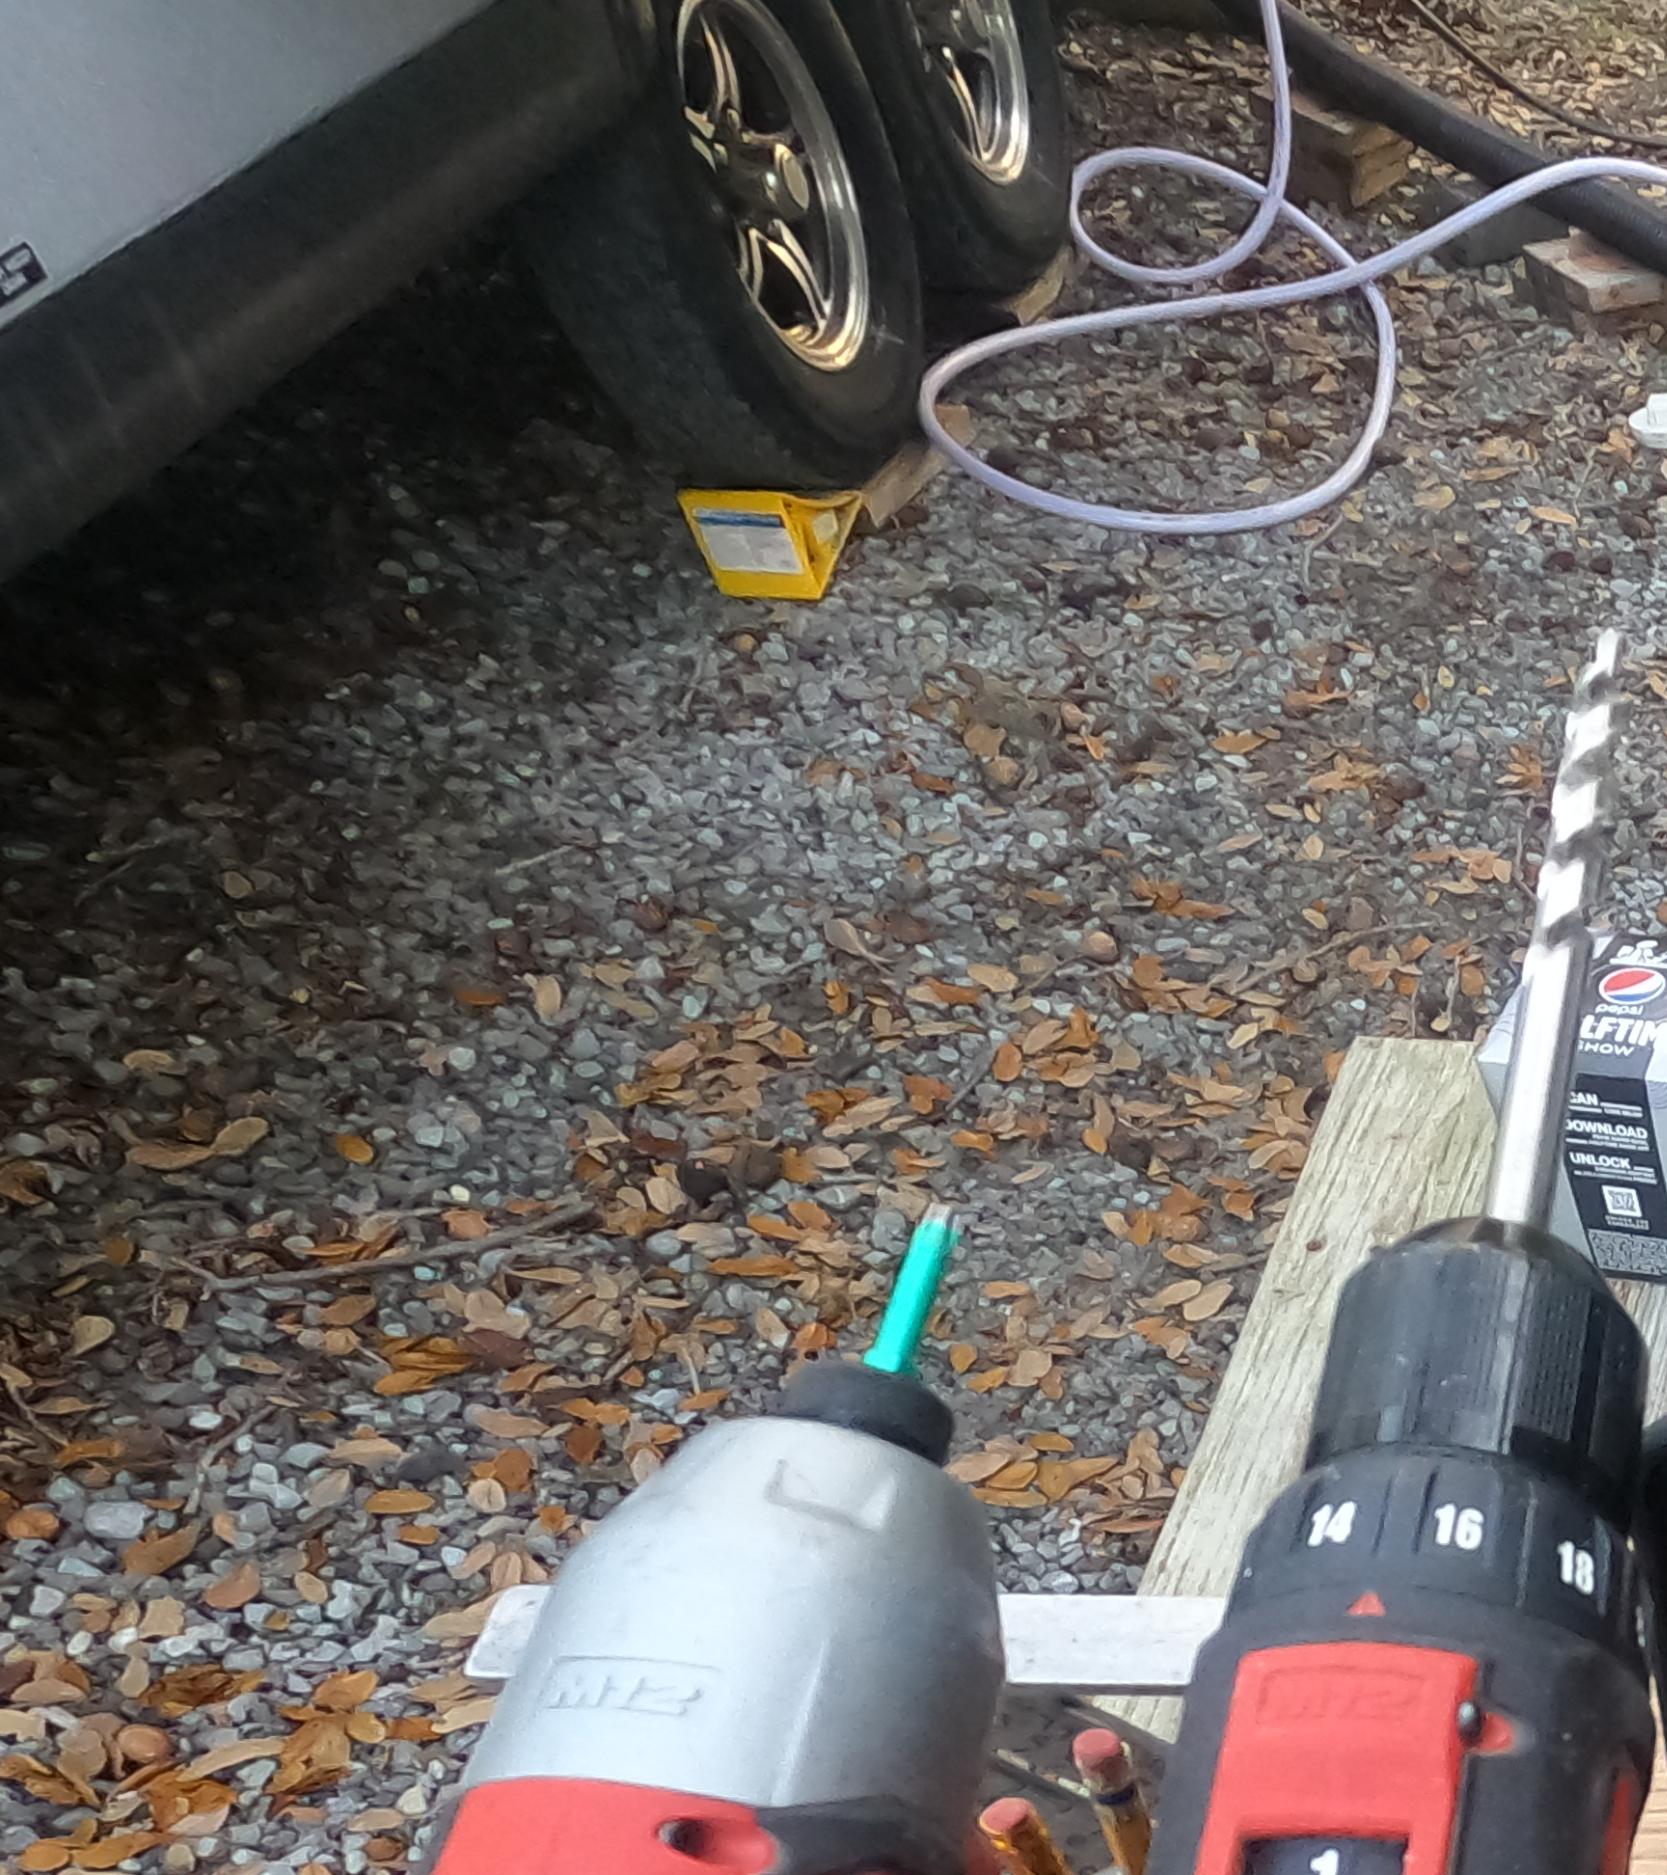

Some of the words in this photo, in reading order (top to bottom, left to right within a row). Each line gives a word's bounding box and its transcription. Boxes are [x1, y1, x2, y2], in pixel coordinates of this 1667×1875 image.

[1595, 1004, 1644, 1015] pepsi
[1569, 1152, 1631, 1169] UNLOCK
[1308, 1501, 1357, 1547] 14
[1434, 1503, 1484, 1551] 16
[1558, 1541, 1595, 1595] 18
